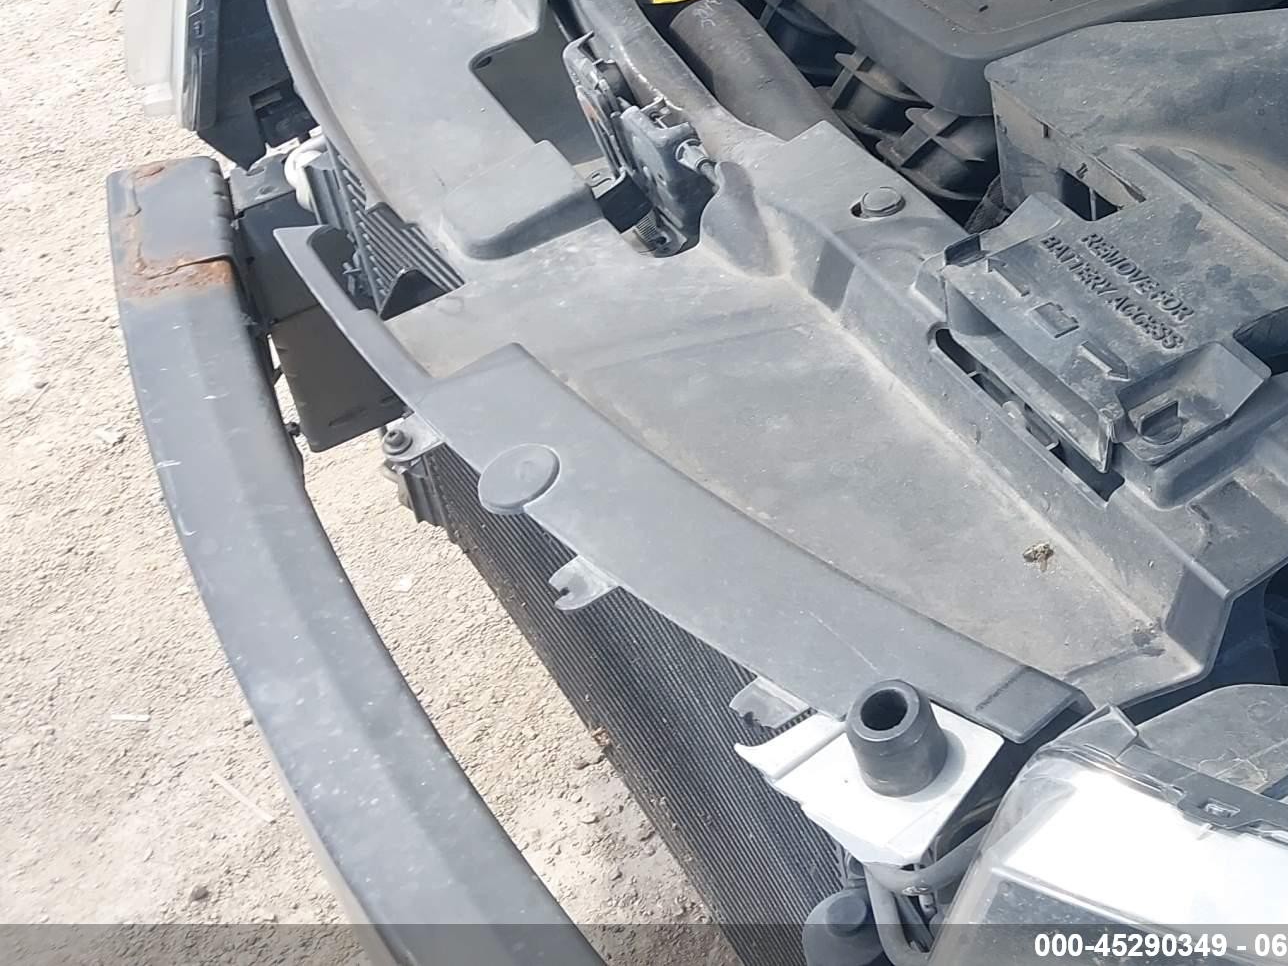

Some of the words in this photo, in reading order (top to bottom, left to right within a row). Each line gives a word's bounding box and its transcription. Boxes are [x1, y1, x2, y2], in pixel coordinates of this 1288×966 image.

[1039, 236, 1119, 296] BATTERY
[1106, 295, 1185, 351] ACCESS
[1080, 233, 1161, 296] REMOVE
[1149, 289, 1196, 322] FOR
